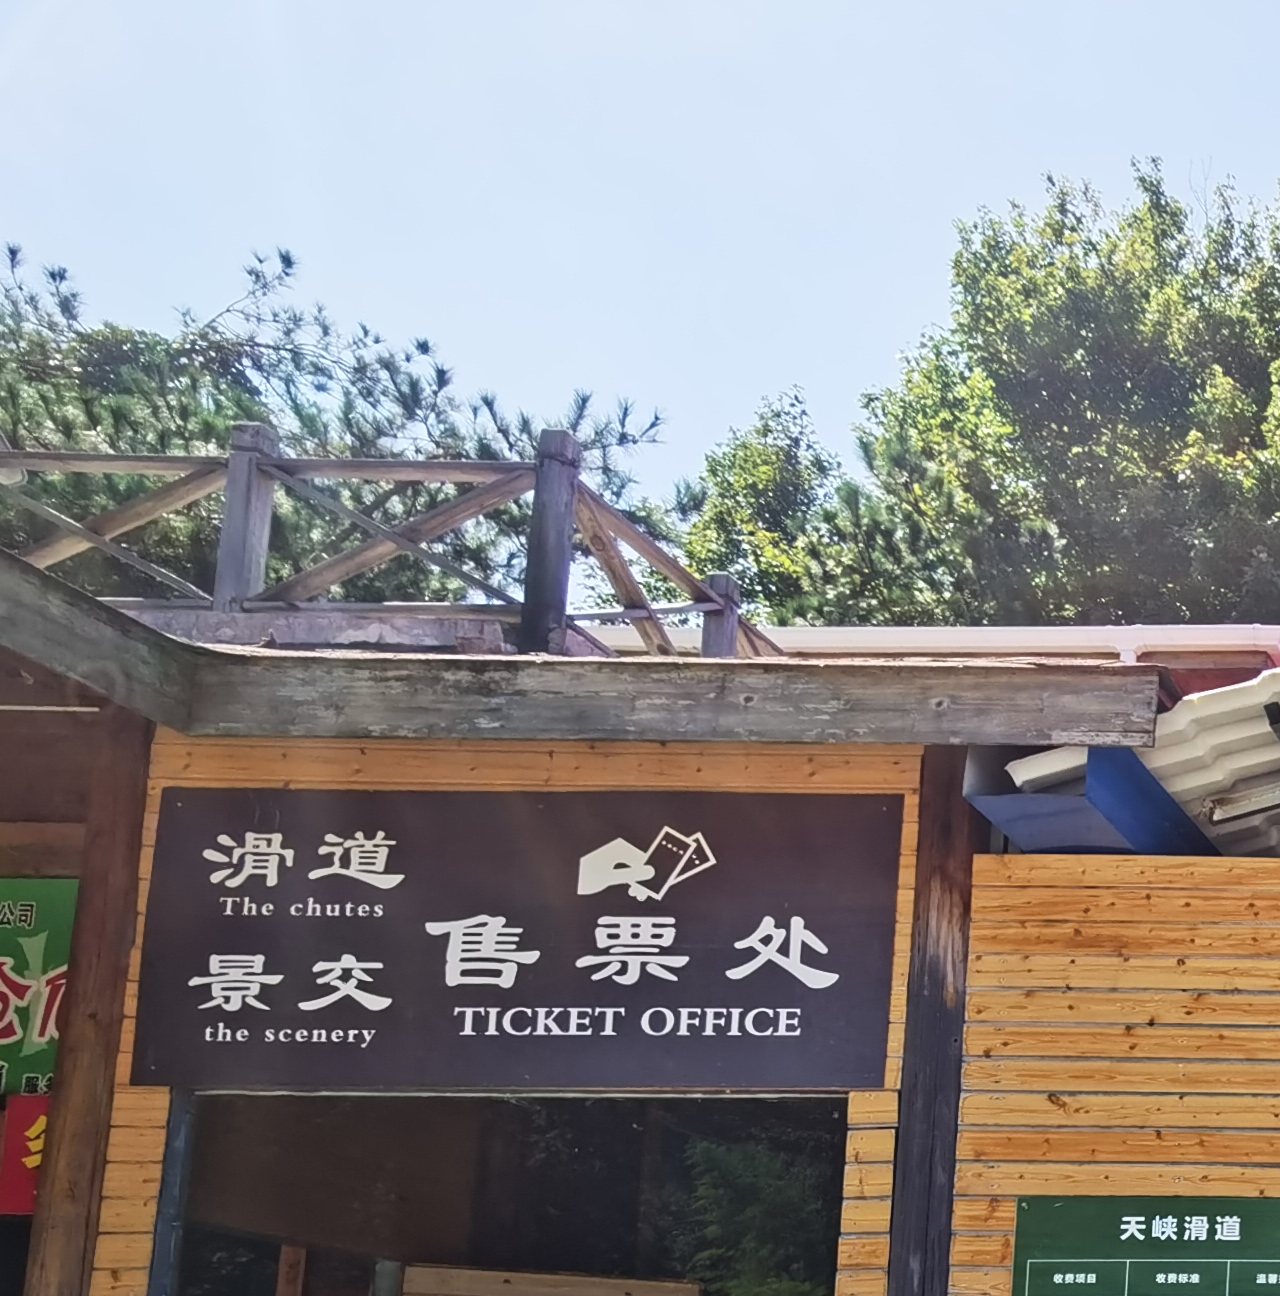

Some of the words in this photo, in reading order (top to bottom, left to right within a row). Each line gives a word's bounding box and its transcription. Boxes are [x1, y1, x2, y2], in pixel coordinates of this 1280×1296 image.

[202, 830, 406, 890] 滑道
[219, 896, 274, 917] The
[289, 896, 385, 918] chutes
[424, 914, 841, 990] 售票处
[188, 952, 393, 1012] 景交
[205, 1022, 250, 1043] the
[264, 1025, 377, 1049] scenery
[453, 1006, 625, 1037] TICKET
[640, 1006, 802, 1037] OFFICE
[1120, 1214, 1242, 1242] 天峡滑道
[1053, 1273, 1097, 1284] 收费项目
[1155, 1272, 1200, 1284] 收费标准
